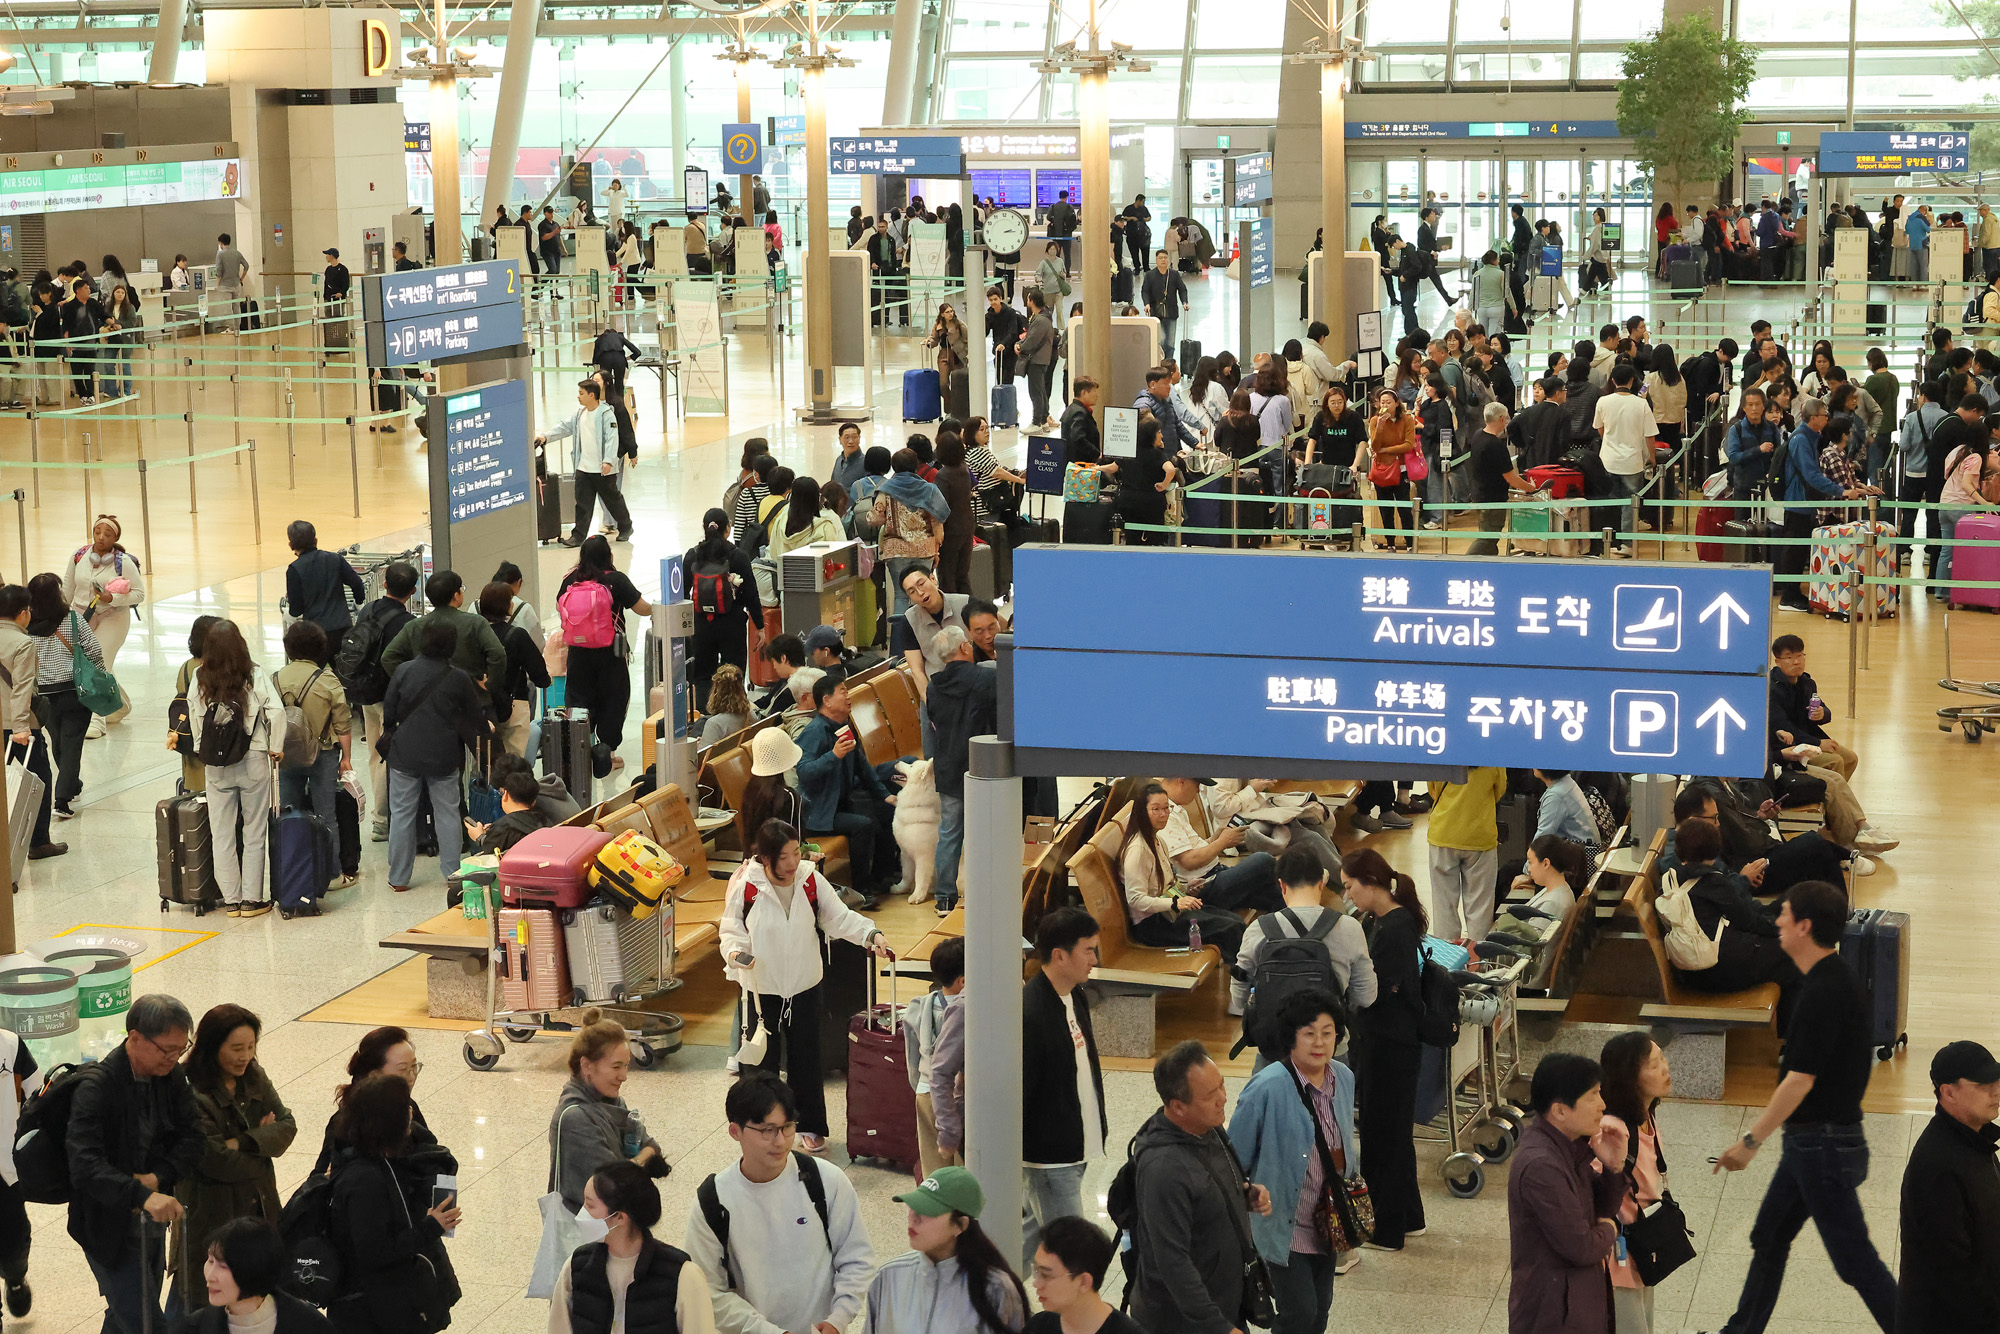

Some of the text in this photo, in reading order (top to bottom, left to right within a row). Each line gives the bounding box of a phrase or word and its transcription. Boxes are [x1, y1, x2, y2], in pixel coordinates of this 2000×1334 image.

[362, 19, 392, 77] D
[1549, 123, 1558, 134] 4
[858, 142, 872, 151] 도착
[1002, 135, 1077, 146] Currency Exchange
[1920, 137, 1936, 147] 도착
[138, 150, 147, 161] D2
[215, 145, 224, 156] D1
[6, 157, 18, 168] D4
[92, 152, 104, 164] D3
[859, 160, 881, 170] 주차장
[1905, 157, 1935, 167] 공항철도
[847, 161, 855, 170] P
[883, 165, 906, 173] Parking
[3, 175, 42, 188] AIR SEOUL
[506, 268, 515, 293] 2
[399, 283, 434, 304] 국제선탑승
[450, 288, 477, 304] Boarding
[405, 331, 414, 353] P
[419, 327, 442, 349] 주차장
[445, 334, 468, 350] Parking
[1034, 458, 1058, 468] BUSINESS
[1037, 465, 1054, 473] CLASS
[474, 476, 490, 490] Refund
[1363, 577, 1410, 605] 到着
[1448, 580, 1495, 608] 到达
[1517, 596, 1591, 637] 도착
[1373, 616, 1496, 647] Arrivals
[1267, 677, 1338, 706] 駐車場
[1374, 680, 1446, 710] 停车场
[1467, 696, 1588, 742] 주차장
[1628, 701, 1667, 747] P
[1326, 716, 1446, 755] Parking
[109, 937, 140, 950] Recycle
[37, 1010, 71, 1025] 일반쓰레기
[45, 1022, 65, 1031] Waste
